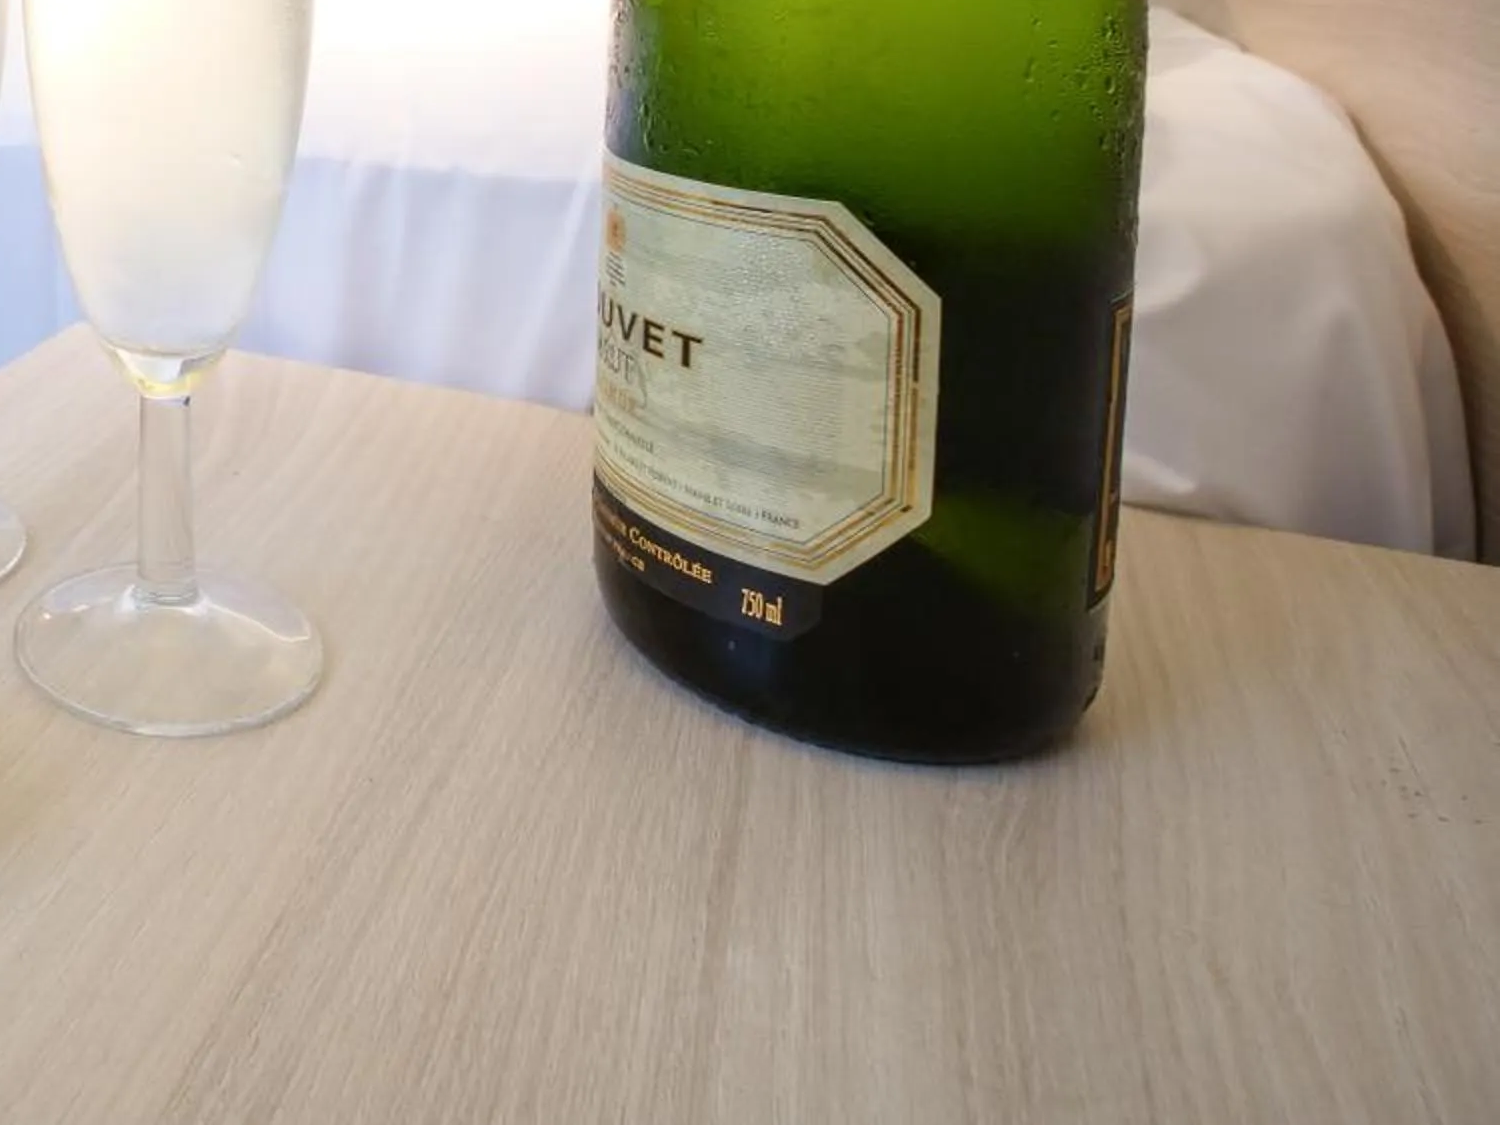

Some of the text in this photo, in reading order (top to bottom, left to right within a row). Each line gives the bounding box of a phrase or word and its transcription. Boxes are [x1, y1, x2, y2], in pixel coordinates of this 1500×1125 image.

[598, 285, 705, 369] UVET
[628, 526, 713, 585] CONTRÔLÉE
[741, 587, 783, 626] 750 ml
